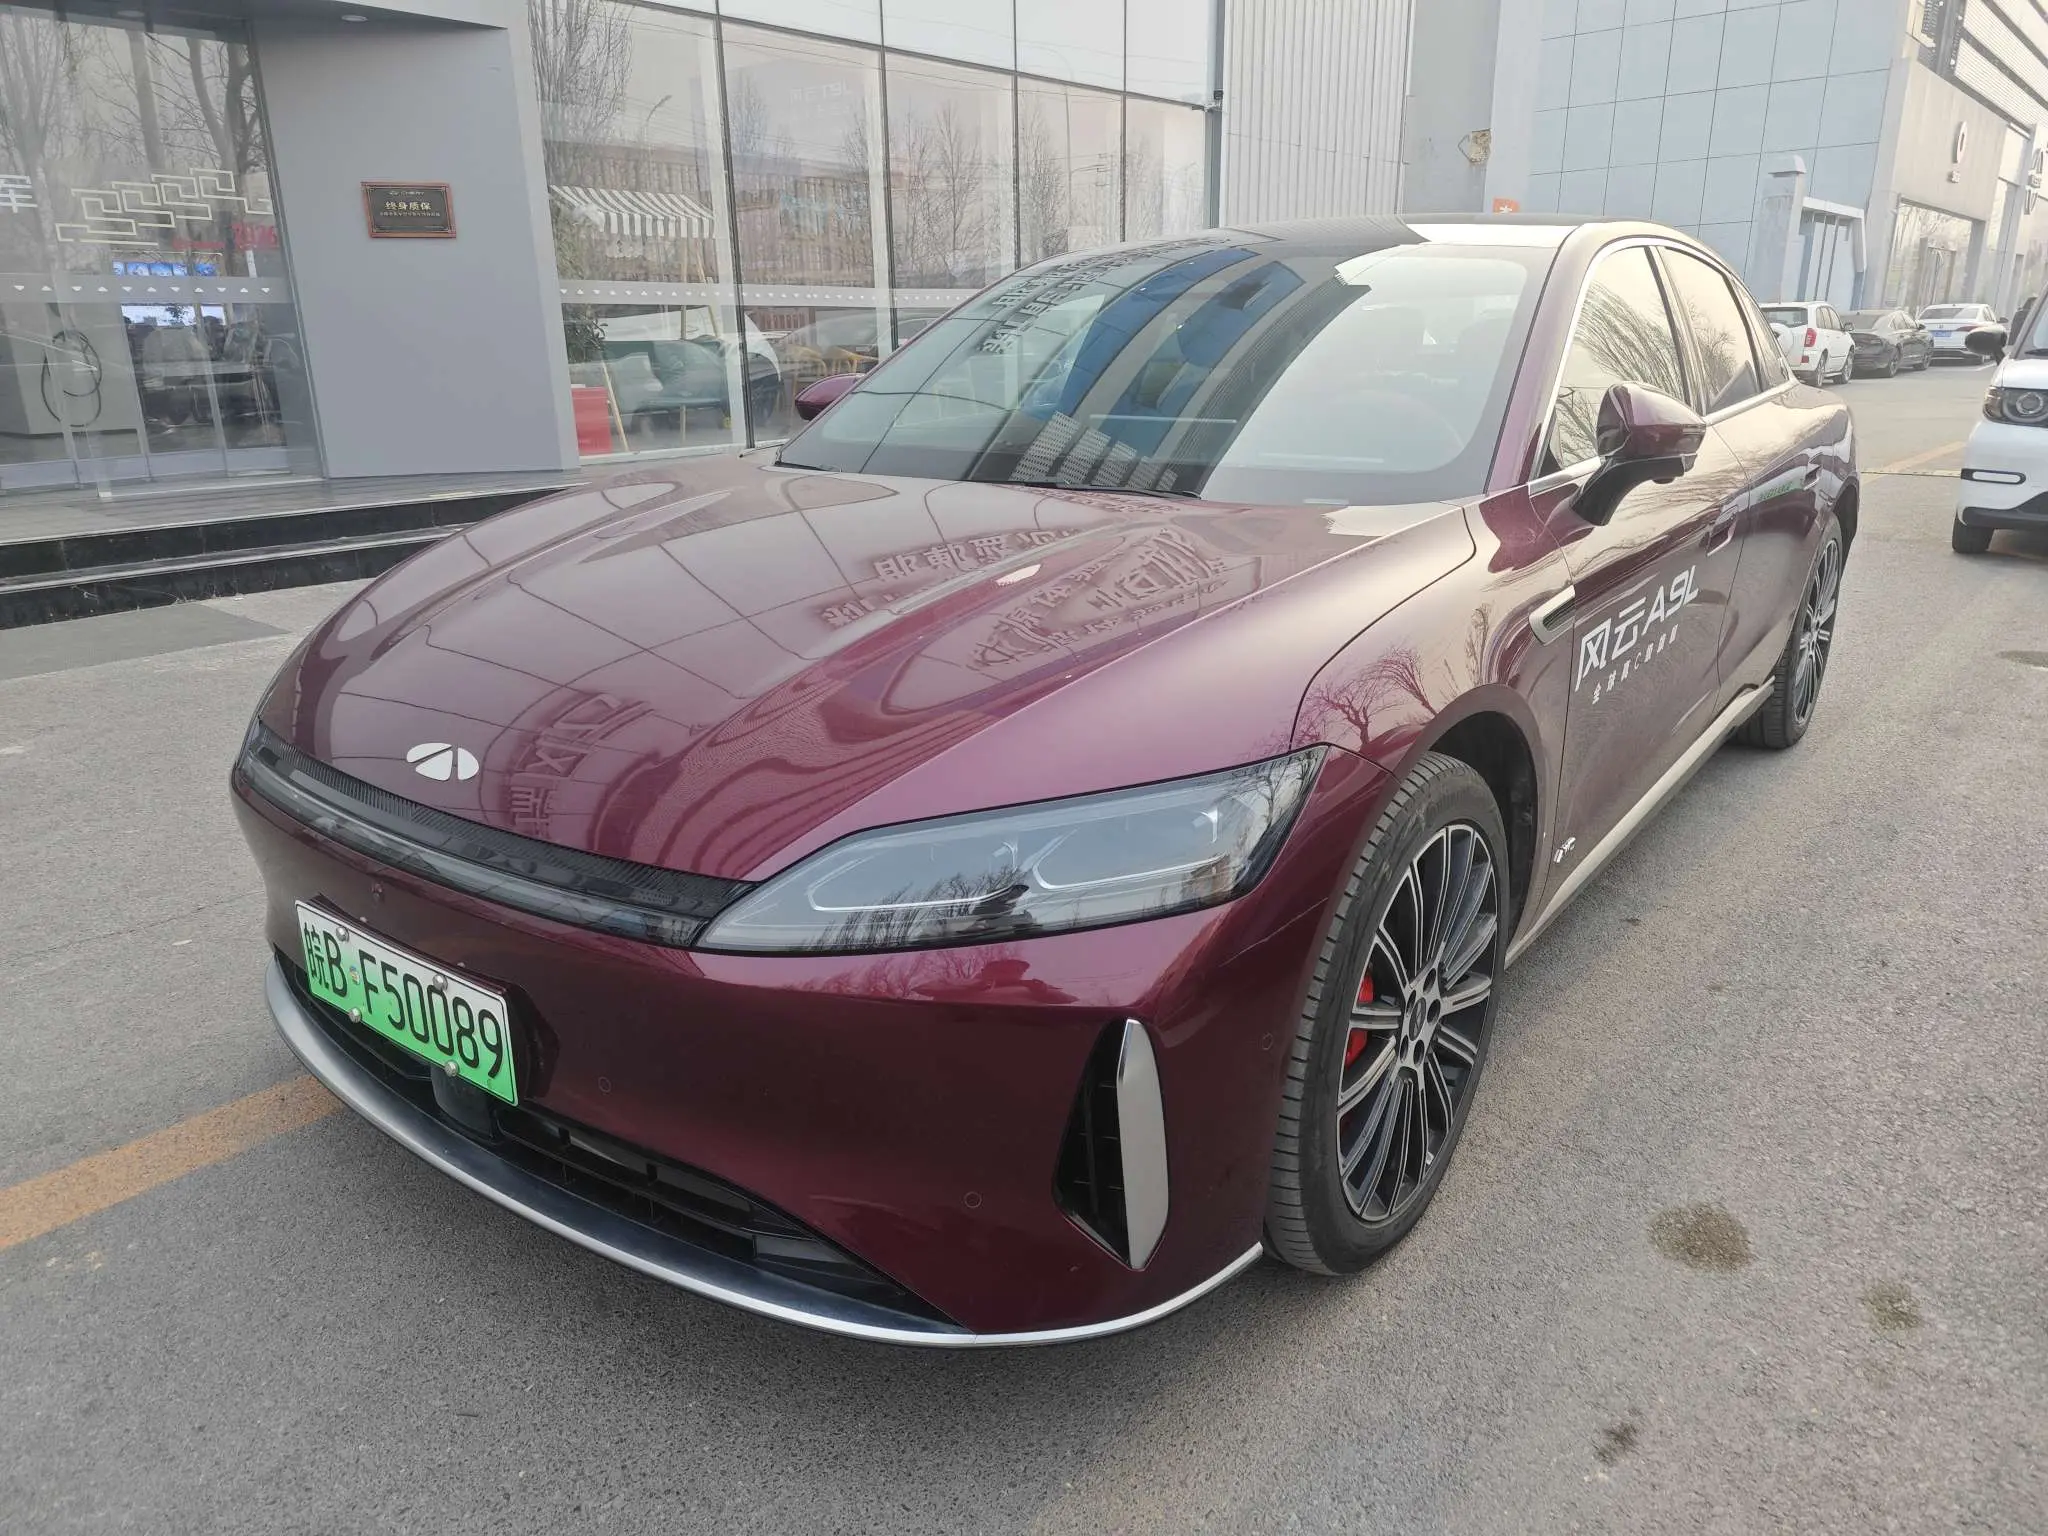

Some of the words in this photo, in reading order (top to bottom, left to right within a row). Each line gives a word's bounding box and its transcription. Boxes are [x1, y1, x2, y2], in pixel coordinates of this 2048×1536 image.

[384, 201, 432, 211] 终身质保
[1574, 565, 1699, 693] 风云A9L
